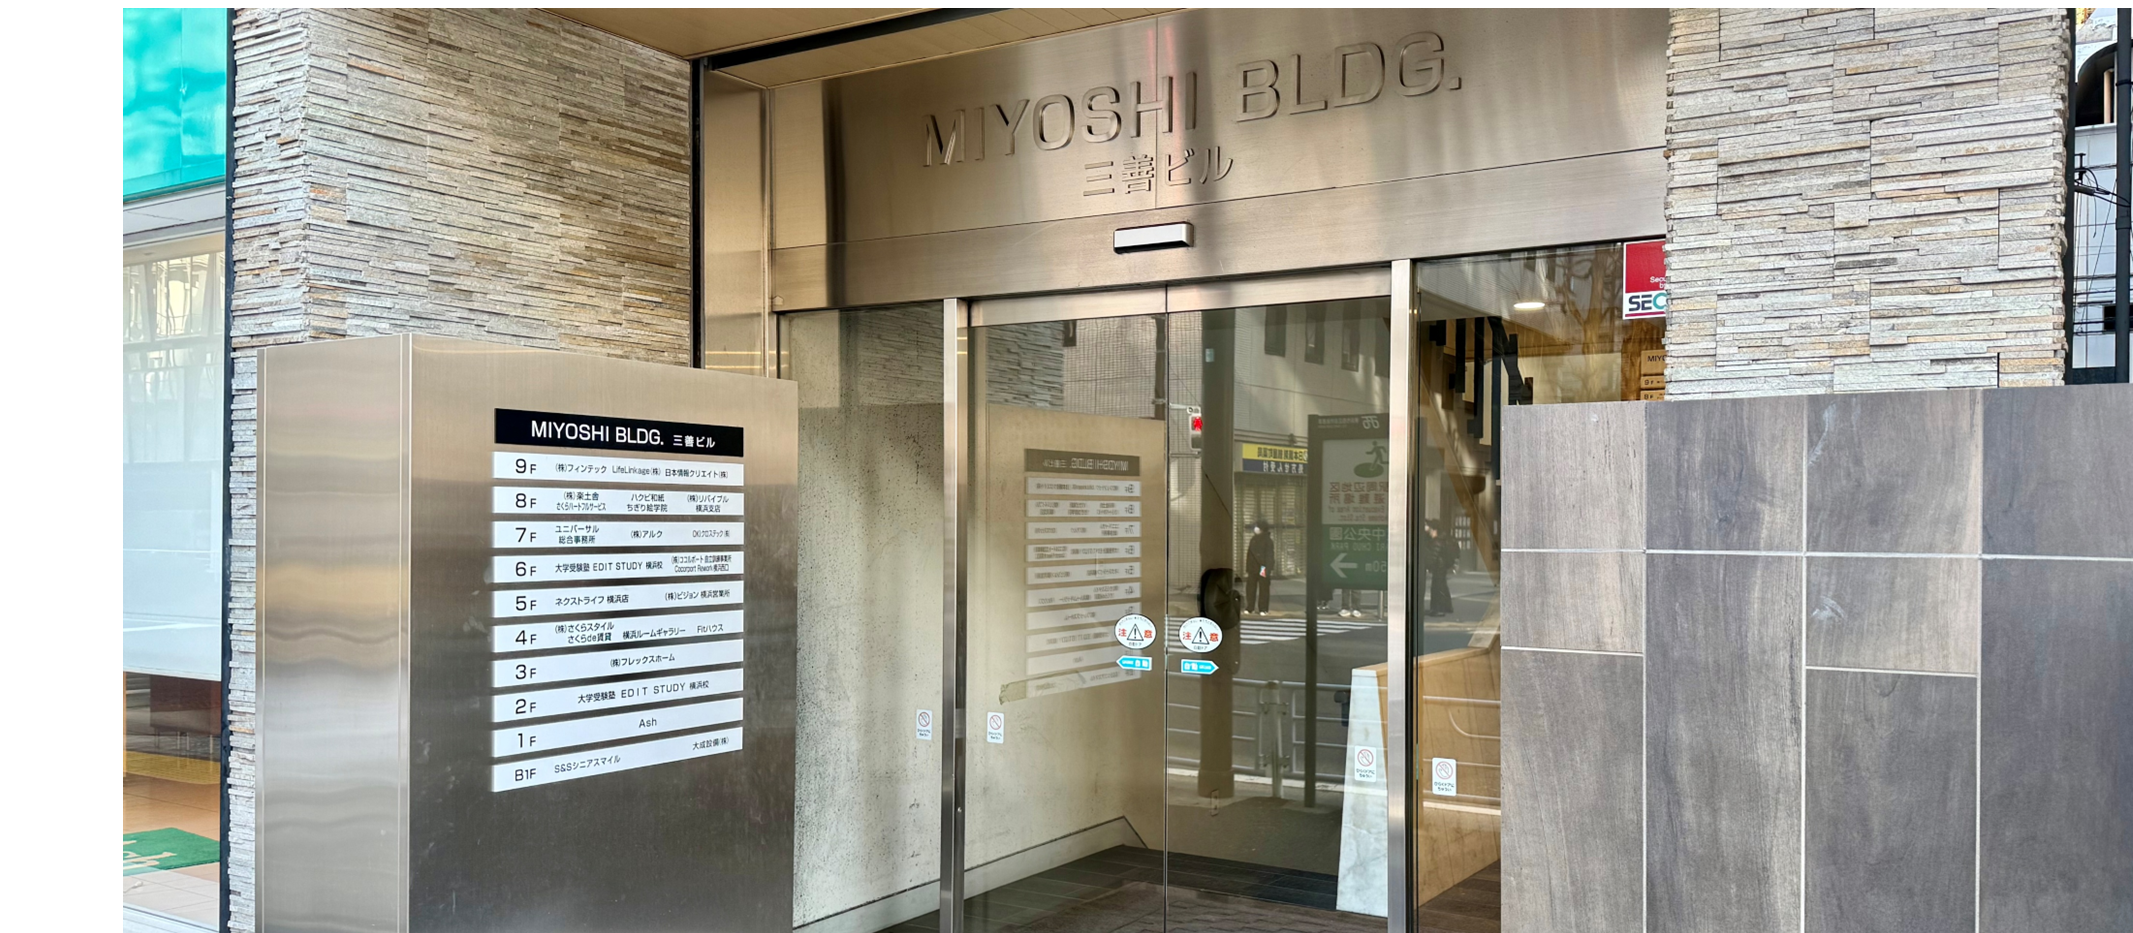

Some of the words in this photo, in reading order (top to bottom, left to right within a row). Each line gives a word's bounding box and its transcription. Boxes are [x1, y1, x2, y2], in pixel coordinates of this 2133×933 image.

[922, 71, 1198, 167] MIYOSHI
[1237, 30, 1462, 123] BLDG.
[1083, 146, 1234, 196] 三善ビル
[531, 420, 609, 442] MIYOSHI
[615, 427, 665, 446] BLDG.
[673, 434, 716, 449] 三善ビル
[515, 459, 537, 475] 9F
[515, 493, 537, 509] 8F
[515, 527, 537, 543] 7F
[515, 562, 537, 577] 6F
[555, 562, 590, 573] 大学受験塾
[593, 562, 613, 572] EDIT
[615, 562, 643, 571] STUDY
[515, 596, 537, 611] 5F
[515, 630, 537, 645] 4F
[1118, 628, 1127, 637] 注
[1183, 632, 1191, 641] 注
[515, 664, 537, 680] 3F
[515, 699, 537, 715] 2F
[577, 692, 616, 704] 大学受験塾
[621, 687, 648, 698] EDIT
[653, 682, 685, 695] STUDY
[517, 733, 537, 748] 1F
[638, 718, 657, 728] Ash
[514, 768, 537, 782] B1F
[554, 755, 621, 774] S&Sシニアスマイル
